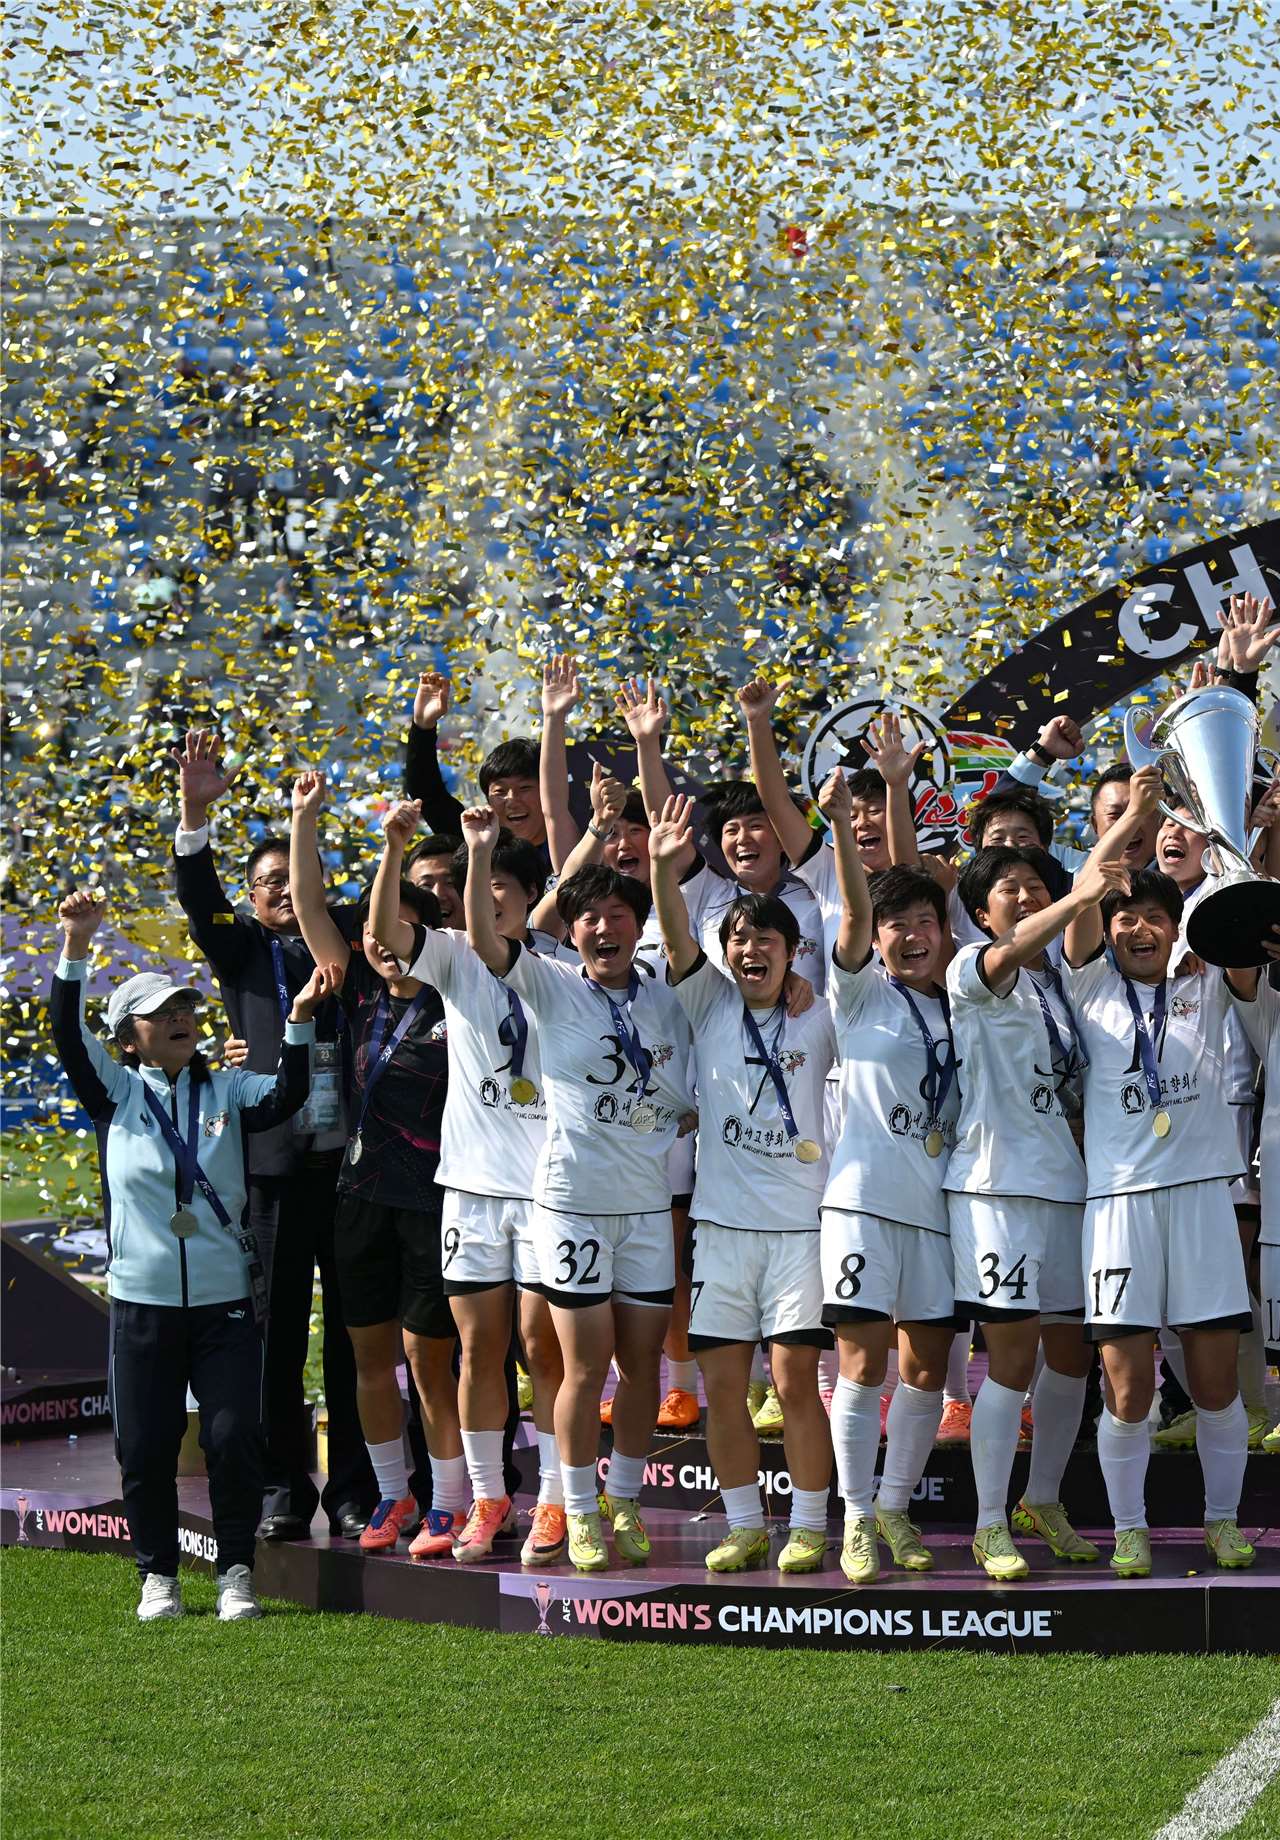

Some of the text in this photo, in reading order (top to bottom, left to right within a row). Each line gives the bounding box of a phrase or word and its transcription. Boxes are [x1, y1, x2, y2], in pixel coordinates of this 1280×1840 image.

[1160, 1072, 1198, 1094] 고향회사
[443, 1227, 461, 1271] 9
[555, 1239, 601, 1285] 32
[835, 1253, 866, 1300] 8
[979, 1252, 1028, 1300] 34
[1092, 1267, 1132, 1317] 17
[0, 1399, 79, 1424] WOMEN'S
[44, 1509, 131, 1541] WOMEN'S
[573, 1599, 712, 1630] WOMEN'S
[718, 1605, 914, 1636] CHAMPIONS
